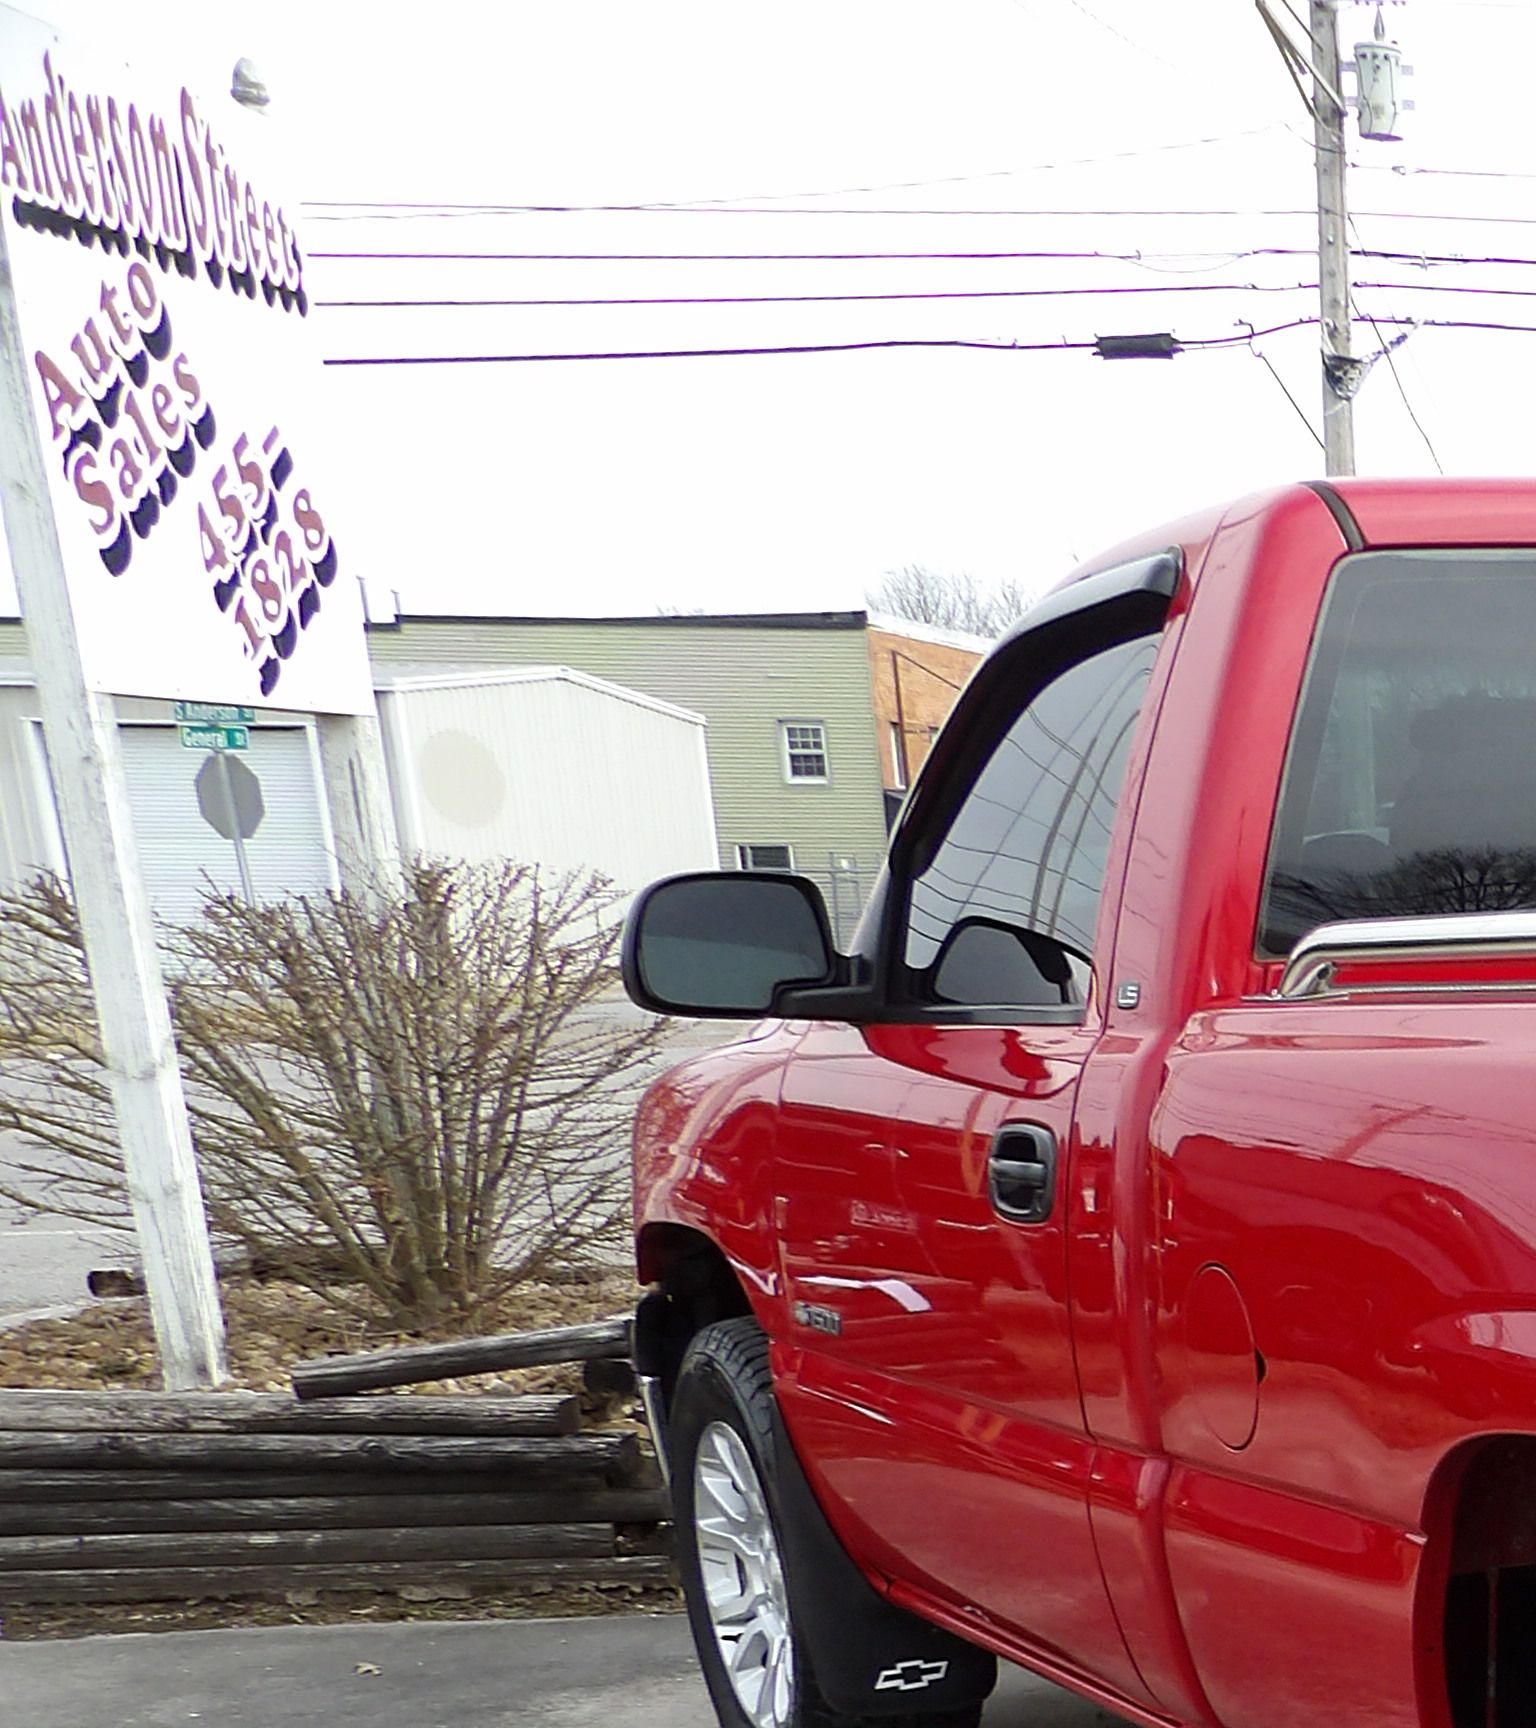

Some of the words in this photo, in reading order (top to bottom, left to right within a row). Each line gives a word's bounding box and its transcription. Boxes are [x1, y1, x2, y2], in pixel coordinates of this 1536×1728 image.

[0, 48, 187, 248] Anderson
[180, 86, 300, 284] Street
[34, 262, 158, 441] Auto
[73, 352, 202, 536] Sales
[199, 424, 281, 573] 455-
[234, 487, 326, 662] 1828
[183, 727, 228, 748] General
[184, 703, 238, 720] Anderson
[1118, 983, 1139, 1006] LS
